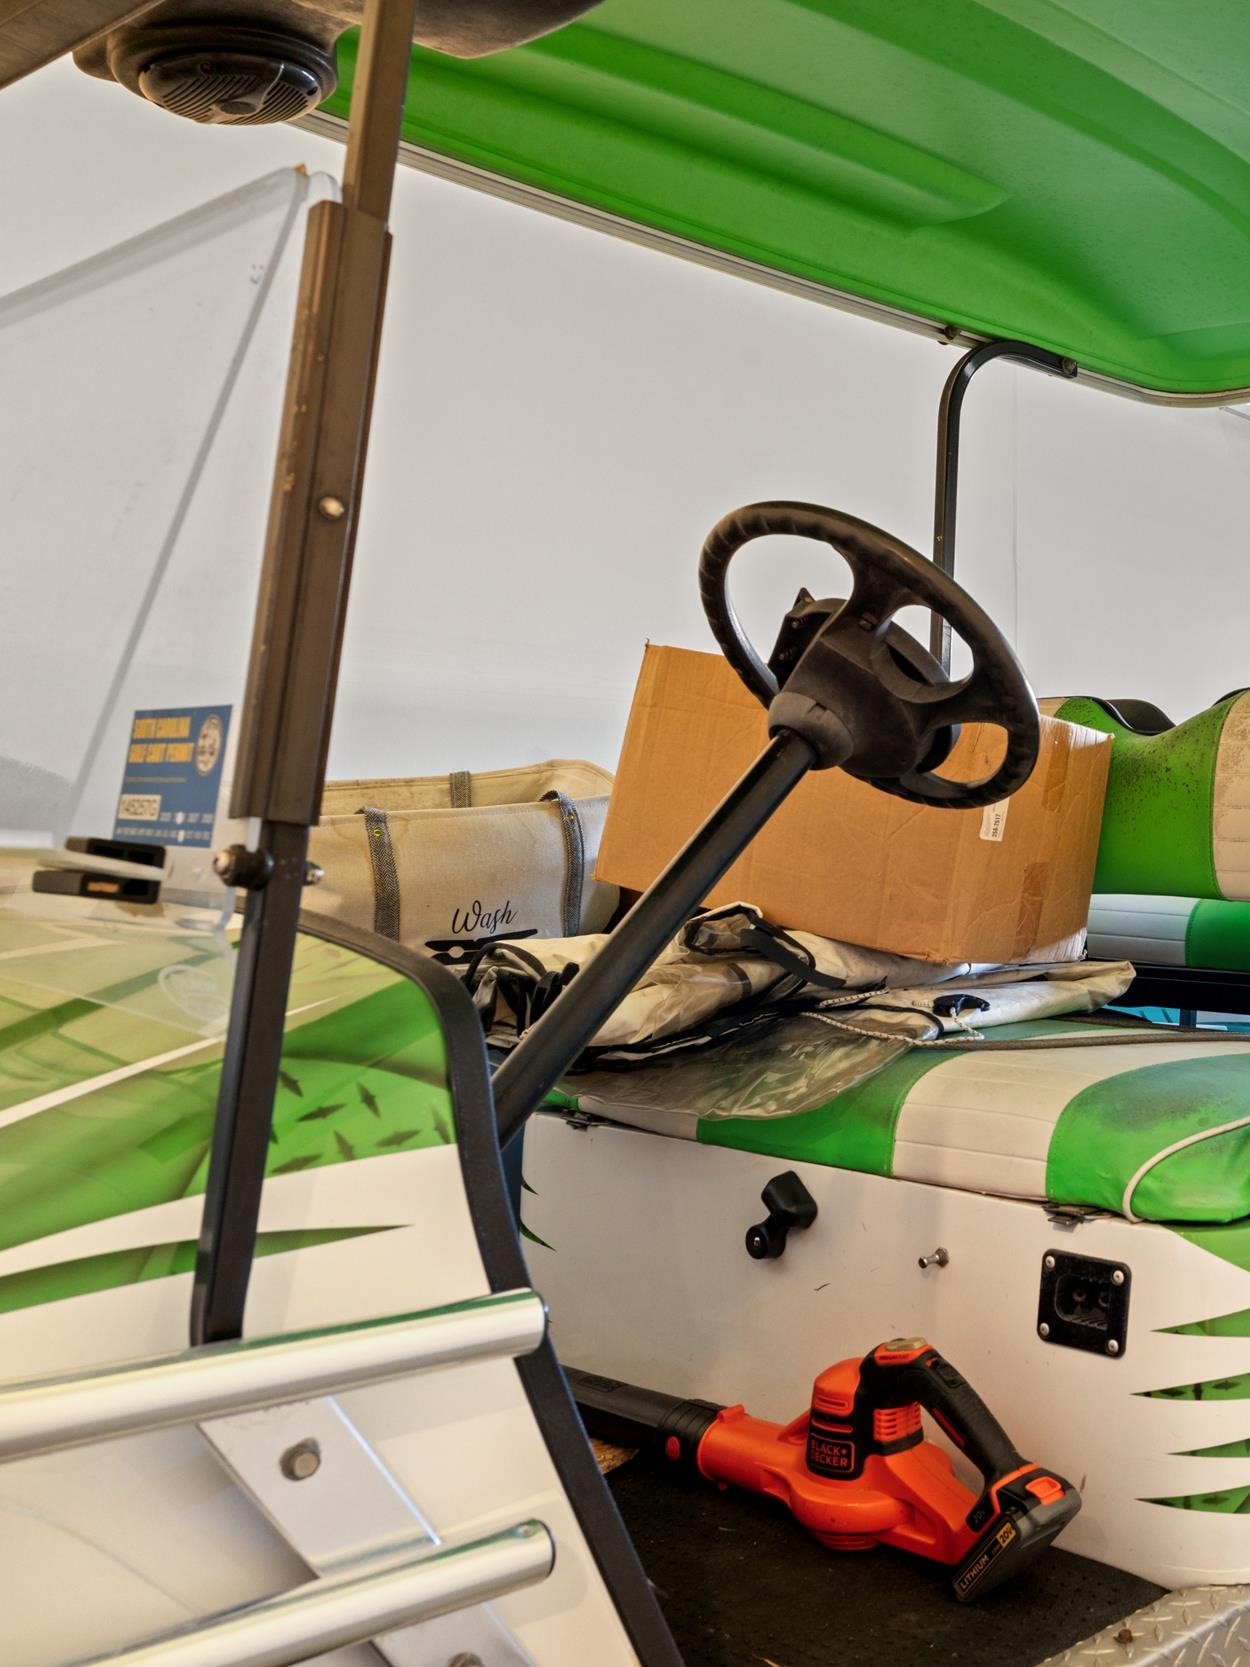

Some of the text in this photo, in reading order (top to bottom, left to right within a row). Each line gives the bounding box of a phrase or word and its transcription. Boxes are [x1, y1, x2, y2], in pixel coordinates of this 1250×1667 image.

[451, 900, 518, 934] Wash
[810, 1449, 849, 1467] DECKER
[960, 1553, 990, 1590] LITHIUM
